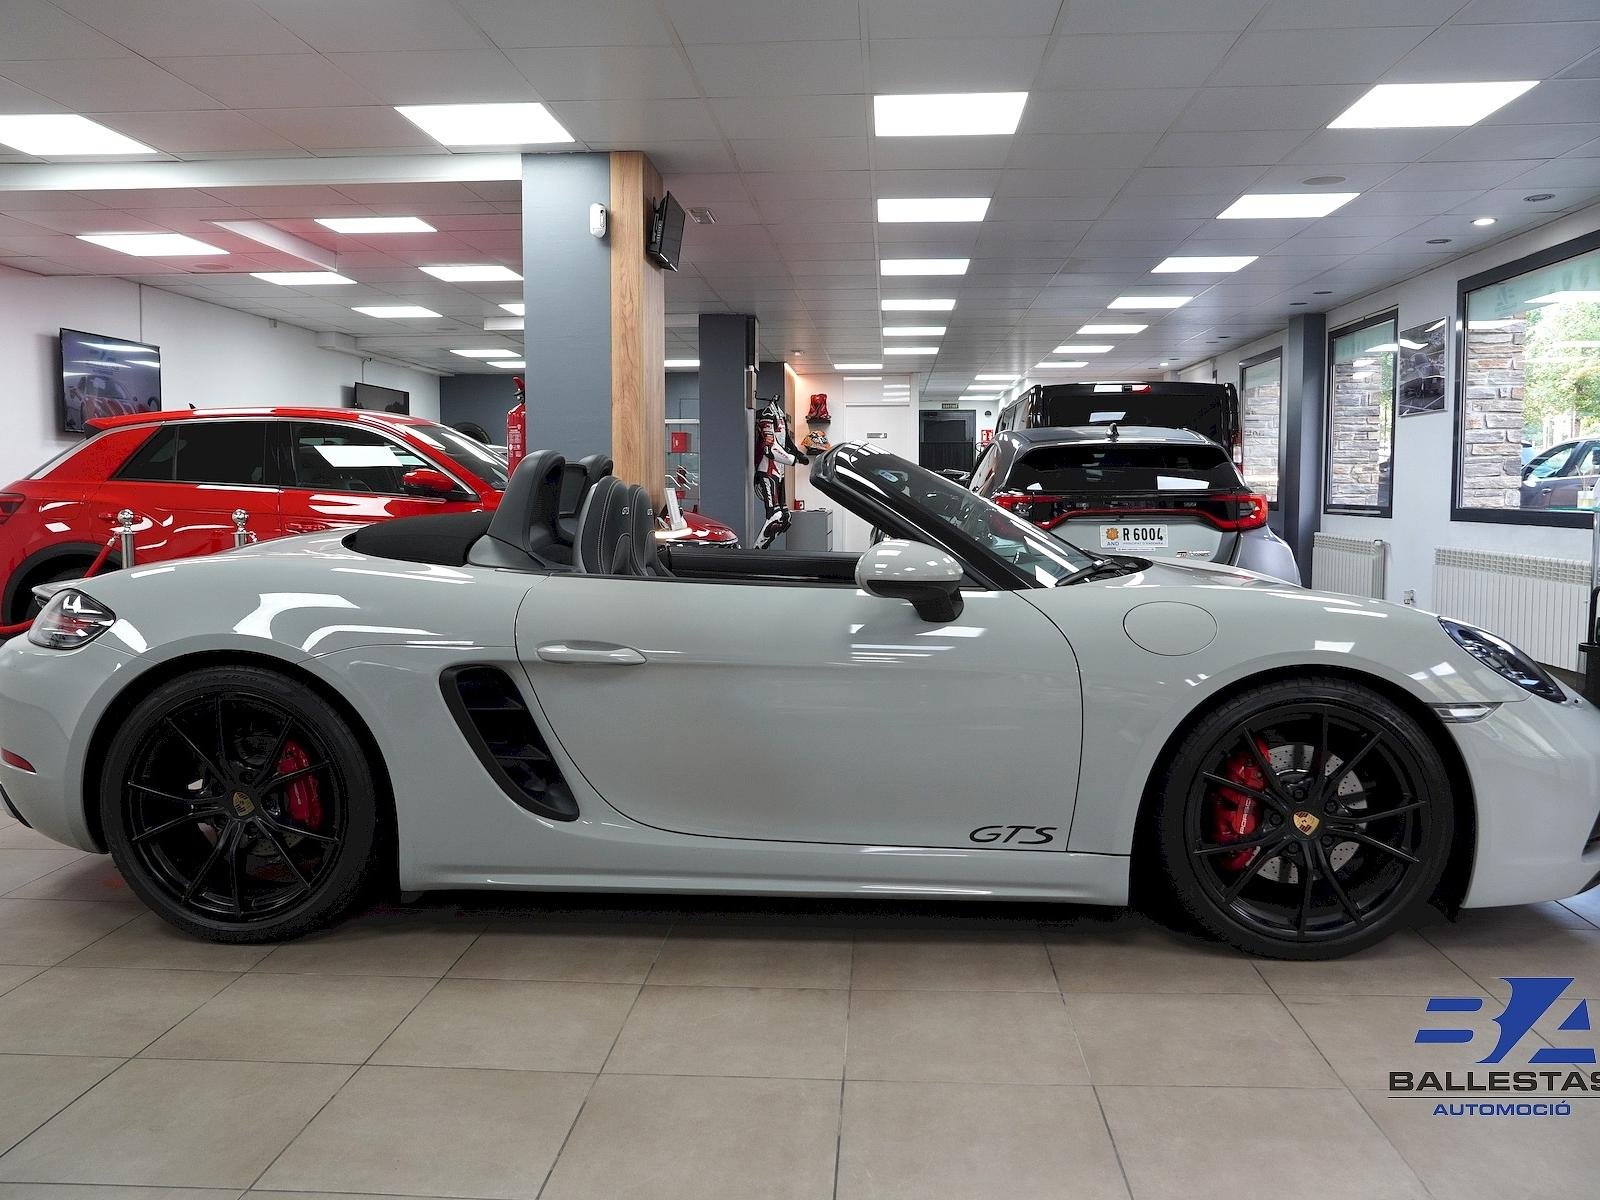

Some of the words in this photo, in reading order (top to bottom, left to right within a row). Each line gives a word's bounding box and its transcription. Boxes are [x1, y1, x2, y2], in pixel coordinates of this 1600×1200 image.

[1122, 527, 1130, 541] R
[1133, 527, 1163, 541] 6004
[969, 825, 1058, 845] GTS
